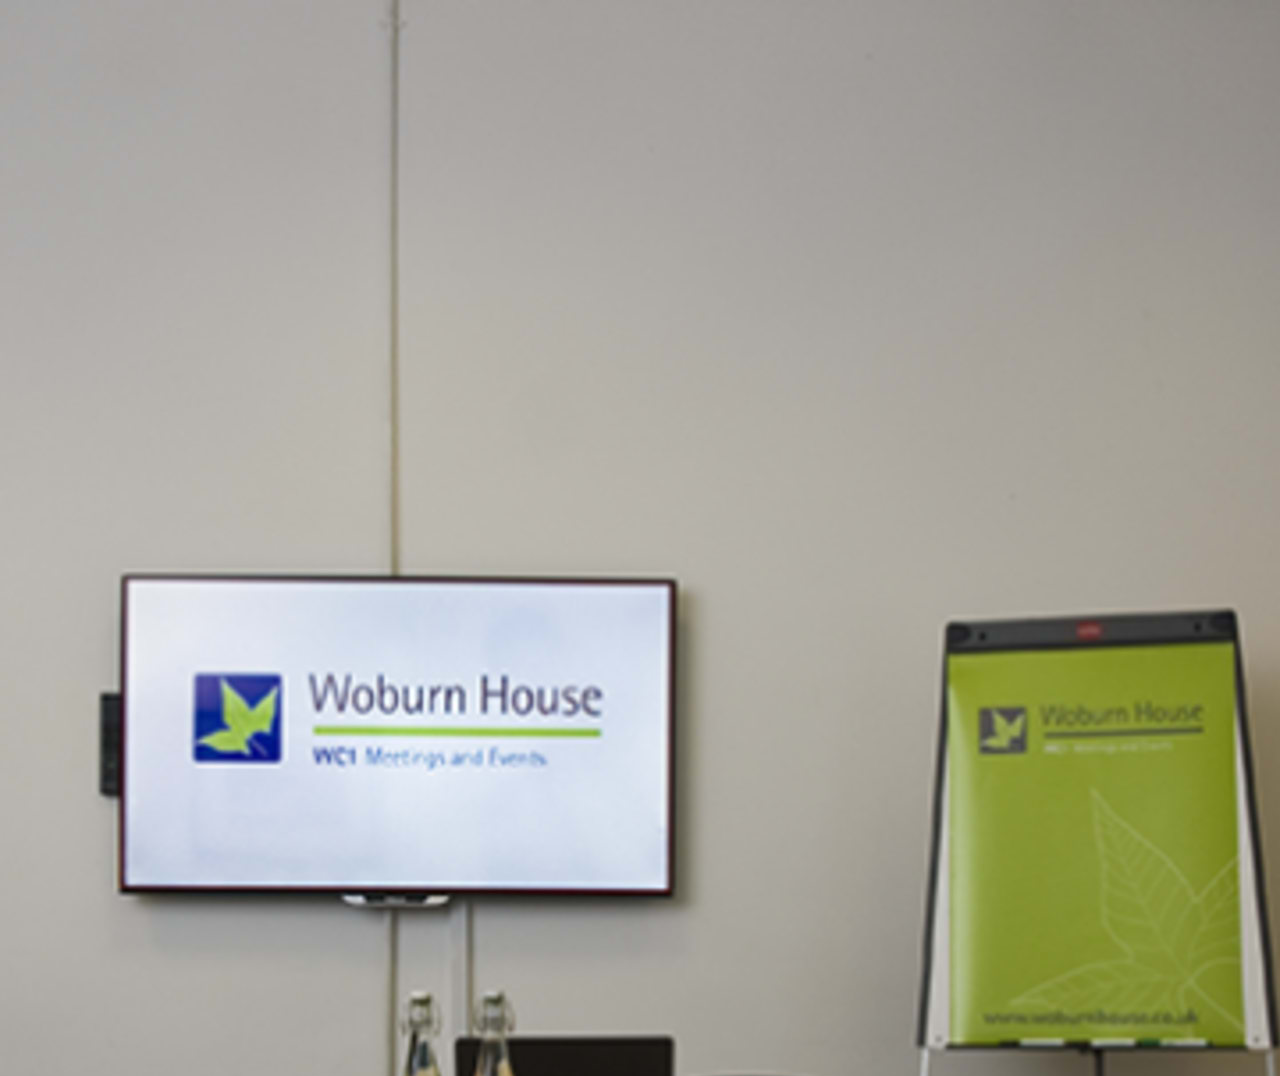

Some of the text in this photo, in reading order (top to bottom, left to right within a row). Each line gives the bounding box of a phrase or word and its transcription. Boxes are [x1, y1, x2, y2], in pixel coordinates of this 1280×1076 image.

[309, 673, 603, 716] Woburn House
[1040, 700, 1205, 726] Woburn House
[313, 747, 547, 770] WC1 Meetings and Events
